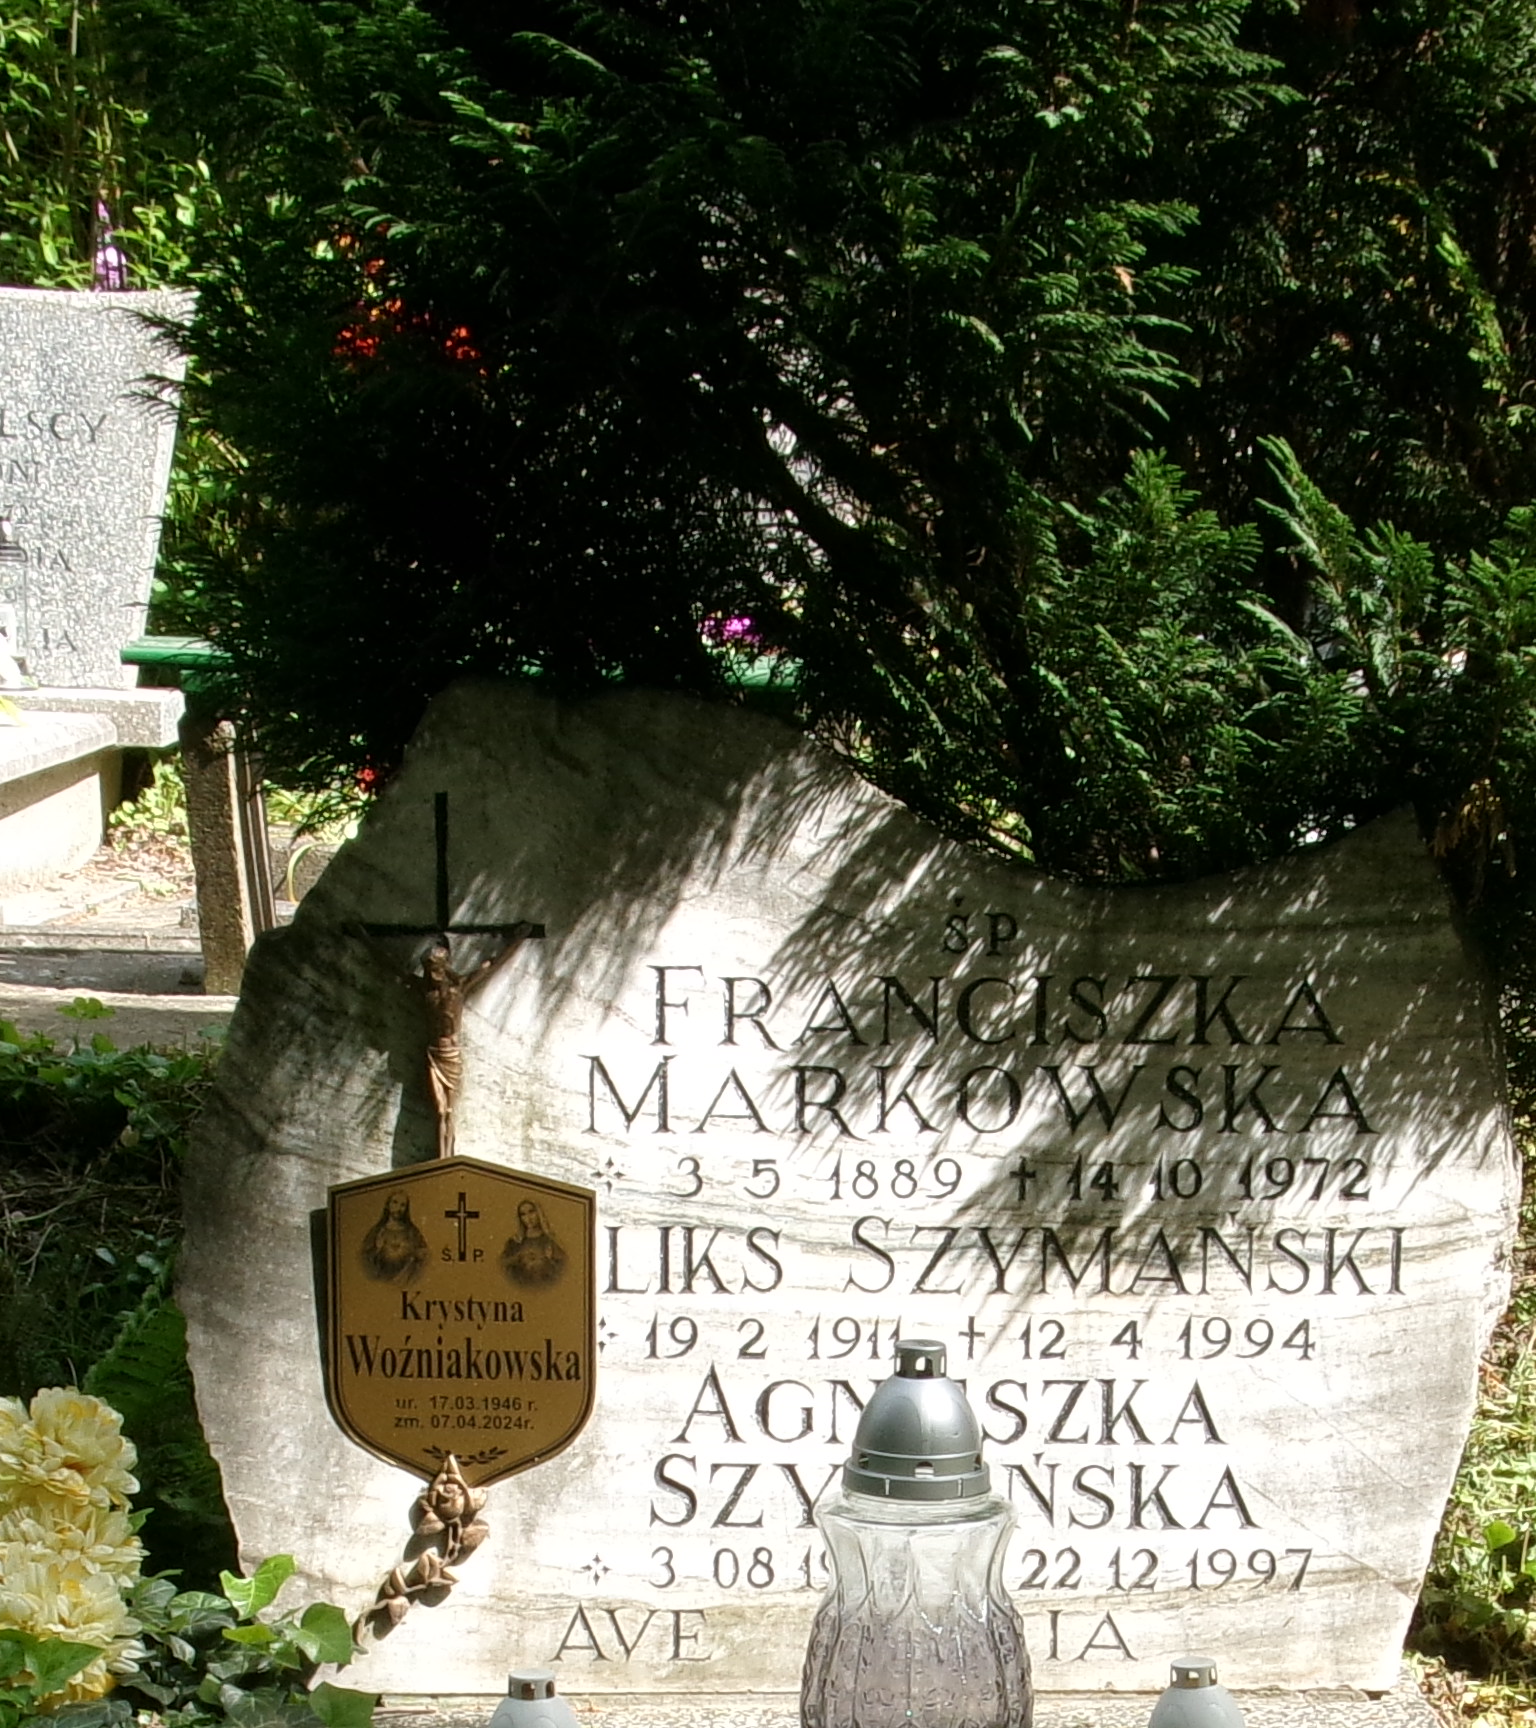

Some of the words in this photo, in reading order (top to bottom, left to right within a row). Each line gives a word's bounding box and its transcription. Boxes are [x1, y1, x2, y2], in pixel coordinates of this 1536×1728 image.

[647, 963, 1345, 1052] FRANCISZKA
[578, 1054, 1381, 1141] MARKOWSKA
[668, 1157, 703, 1198] 3
[744, 1158, 780, 1199] 5
[828, 1150, 963, 1200] 1889
[1066, 1155, 1119, 1201] 14
[1150, 1154, 1203, 1201] 10
[1238, 1156, 1371, 1202] 1972
[602, 1225, 783, 1296] LIKS
[842, 1211, 1406, 1296] SZYMAŃSKI
[400, 1289, 525, 1330] Krystyna
[645, 1311, 699, 1360] 19
[737, 1318, 768, 1360] 2
[807, 1312, 902, 1360] 1911
[1019, 1315, 1066, 1360] 12
[1110, 1319, 1143, 1360] 4
[1178, 1313, 1316, 1360] 1994
[345, 1333, 582, 1382] Woźniakowska
[429, 1396, 522, 1412] 17.03.1946
[649, 1452, 1263, 1531] SZYŃSKA
[649, 1545, 676, 1588] 3
[712, 1546, 776, 1589] 08
[1018, 1544, 1084, 1592] 22
[1108, 1545, 1159, 1592] 12
[1186, 1547, 1314, 1592] 1997
[549, 1601, 715, 1663] AVE
